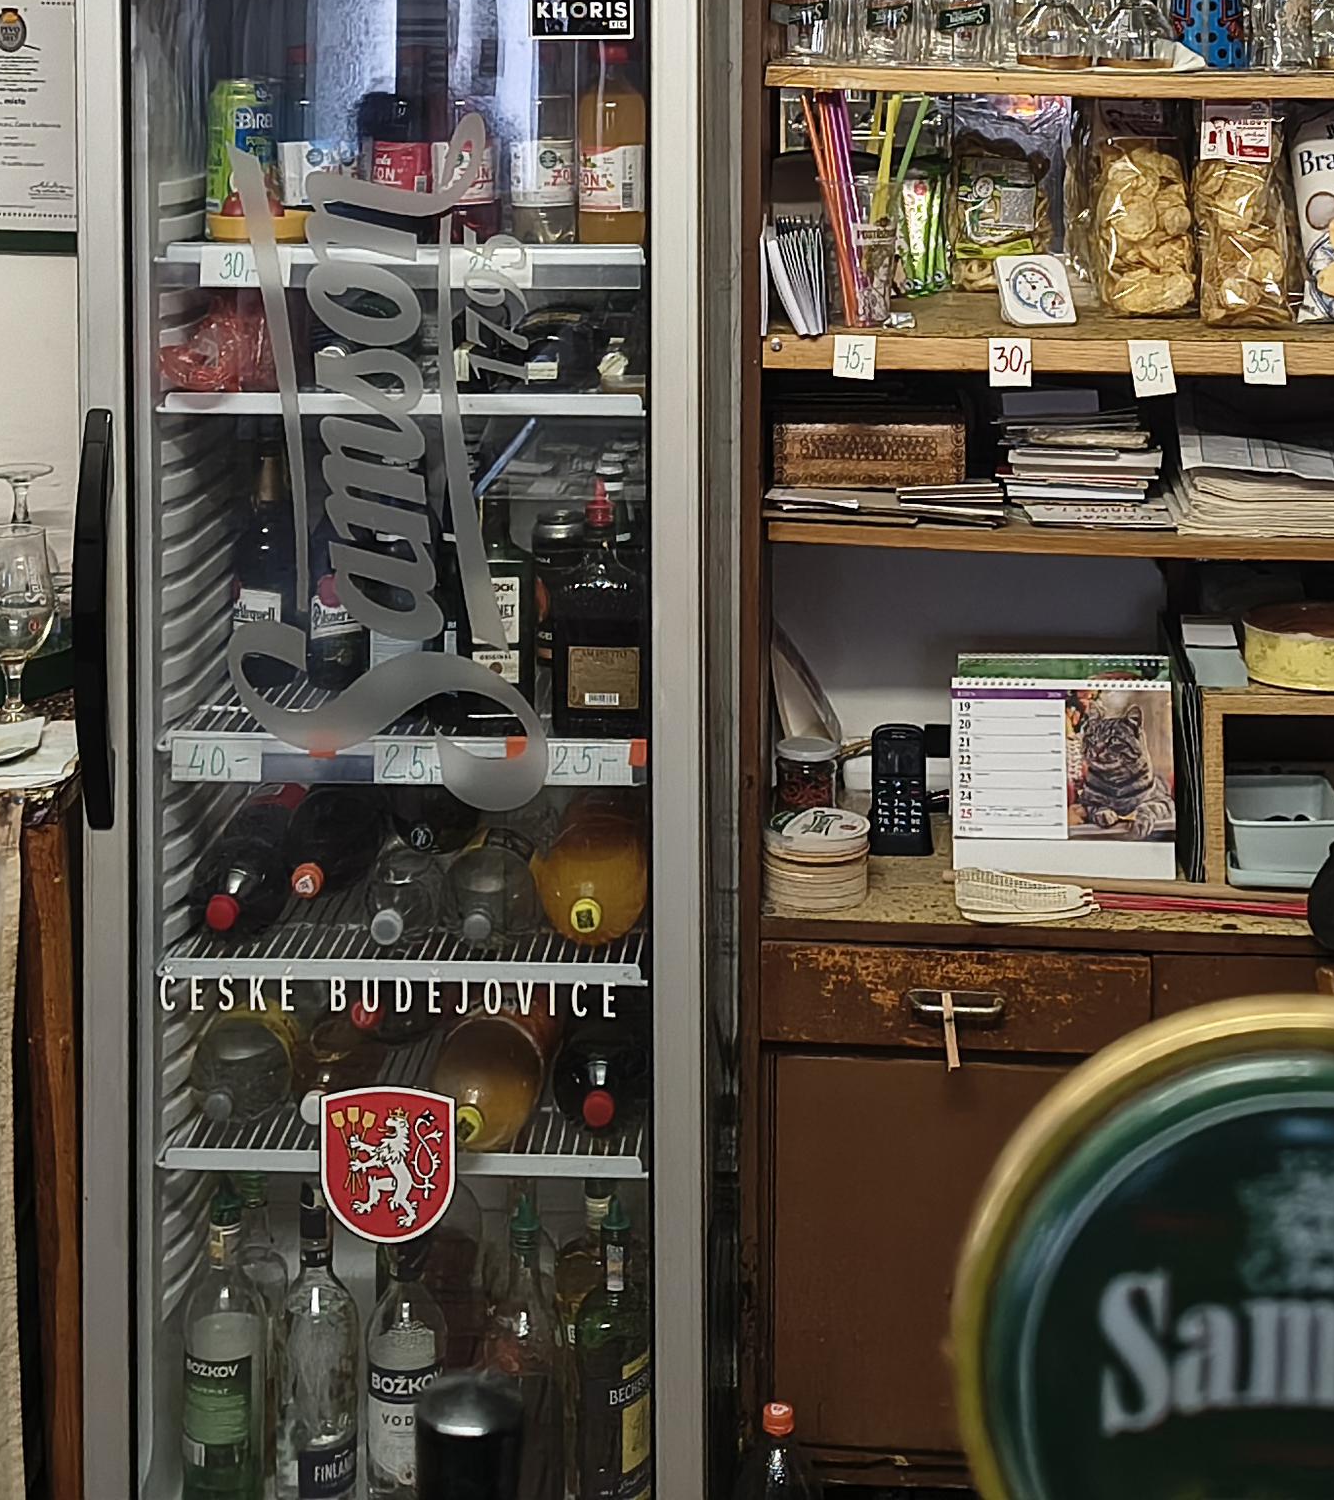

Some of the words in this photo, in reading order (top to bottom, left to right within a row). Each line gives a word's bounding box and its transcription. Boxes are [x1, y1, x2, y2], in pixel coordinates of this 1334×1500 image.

[536, 1, 628, 19] KHORIS
[464, 225, 531, 384] 1795
[227, 112, 548, 812] Samson
[959, 701, 971, 712] 19
[959, 719, 971, 730] 20
[959, 737, 971, 747] 21
[959, 754, 971, 765] 22
[960, 772, 972, 784] 23
[960, 790, 972, 801] 24
[961, 808, 973, 820] 25
[160, 965, 296, 1012] ČESKÉ
[330, 969, 618, 1019] BUDĚJOVICE
[186, 1358, 240, 1378] BOŽKOV
[381, 1412, 415, 1427] VOD
